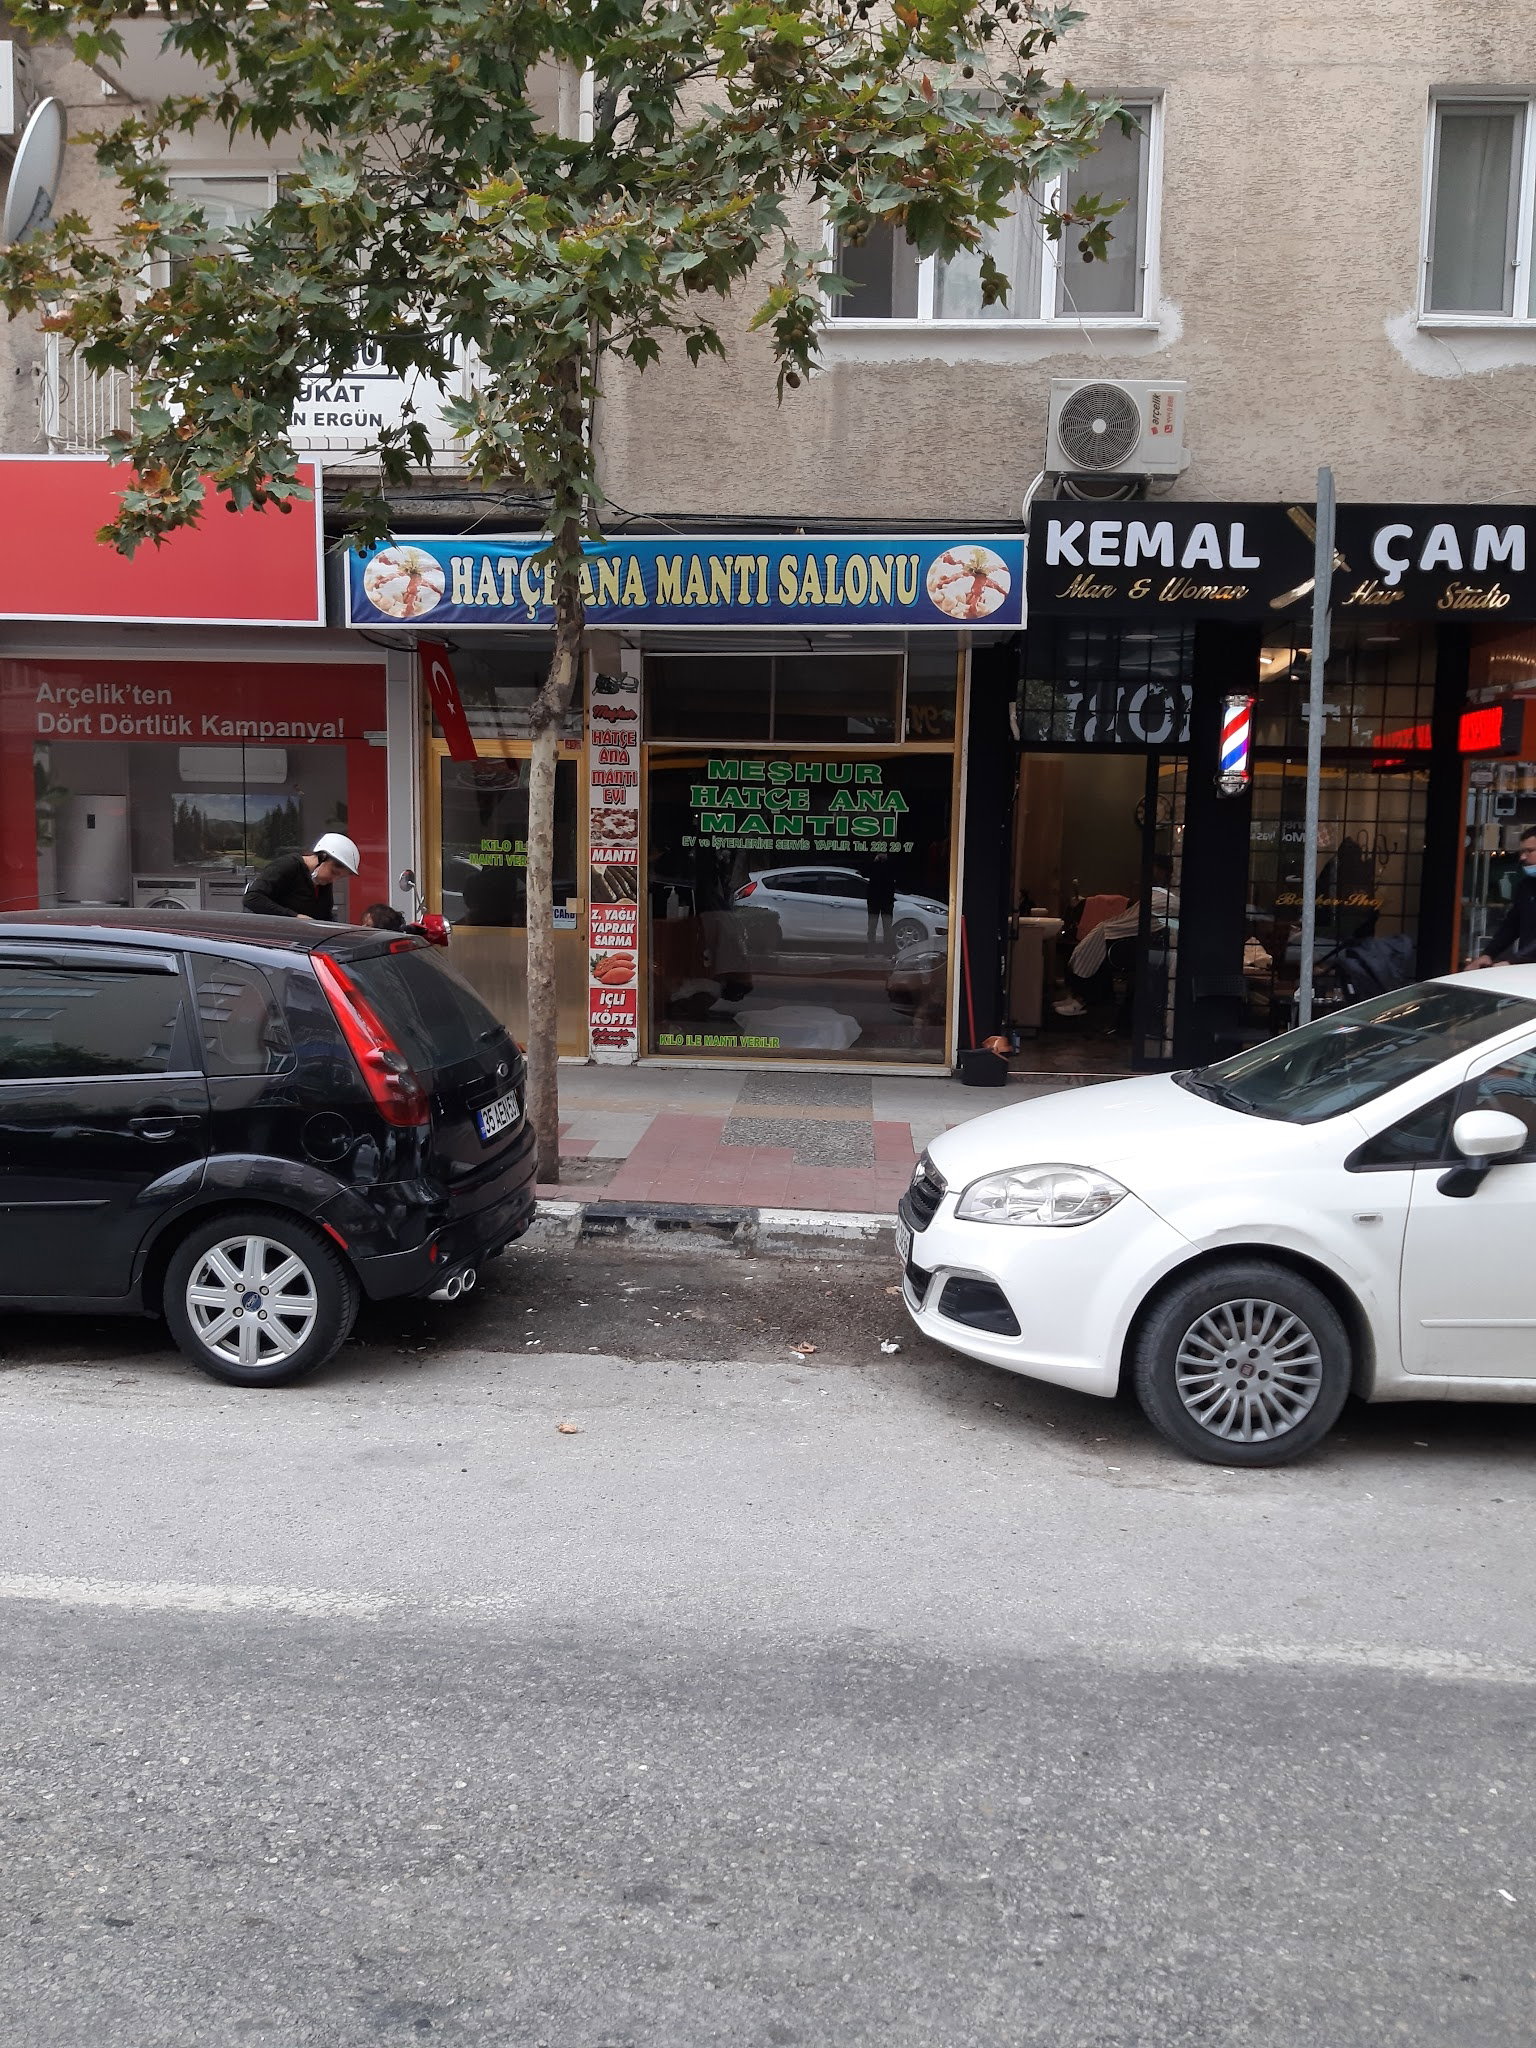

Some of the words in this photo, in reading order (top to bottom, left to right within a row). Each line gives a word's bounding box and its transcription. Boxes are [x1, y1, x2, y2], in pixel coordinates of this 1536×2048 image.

[299, 384, 365, 402] UKAT
[314, 409, 382, 426] ERGÜN
[1152, 394, 1161, 424] arçelik
[1046, 520, 1260, 569] KEMAL
[1373, 523, 1526, 586] ÇAM
[655, 554, 770, 605] MANTI
[778, 554, 921, 606] SALONU
[1056, 573, 1117, 598] Man
[1128, 578, 1151, 599] &
[1158, 577, 1249, 602] Woman
[1342, 579, 1405, 606] Hair
[1437, 581, 1511, 609] Studio
[36, 682, 172, 708] Arçelik'ten
[38, 712, 91, 735] Dört
[100, 714, 193, 736] Dörtlük
[202, 715, 345, 743] Kampanya!
[592, 729, 637, 748] HATÇE
[599, 747, 629, 765] ANA
[591, 769, 638, 787] MANTI
[708, 760, 882, 785] MEŞHUR
[603, 786, 626, 804] EVİ
[690, 785, 810, 814] HATÇE
[828, 789, 909, 812] ANA
[700, 812, 896, 837] MANTISI
[481, 839, 511, 852] KİLO
[515, 840, 528, 852] İL
[682, 836, 697, 847] EV
[775, 837, 810, 851] SERVİS
[469, 853, 503, 866] MANTI
[506, 854, 528, 866] VER
[592, 849, 636, 863] MANTI
[605, 907, 636, 921] YAĞLI
[591, 922, 635, 934] YAPRAK
[594, 936, 632, 947] SARMA
[600, 989, 626, 1009] İÇLİ
[591, 1008, 634, 1025] KÖFTE
[660, 1034, 684, 1045] KİLO
[704, 1035, 737, 1047] MANTI
[483, 1108, 495, 1133] 35
